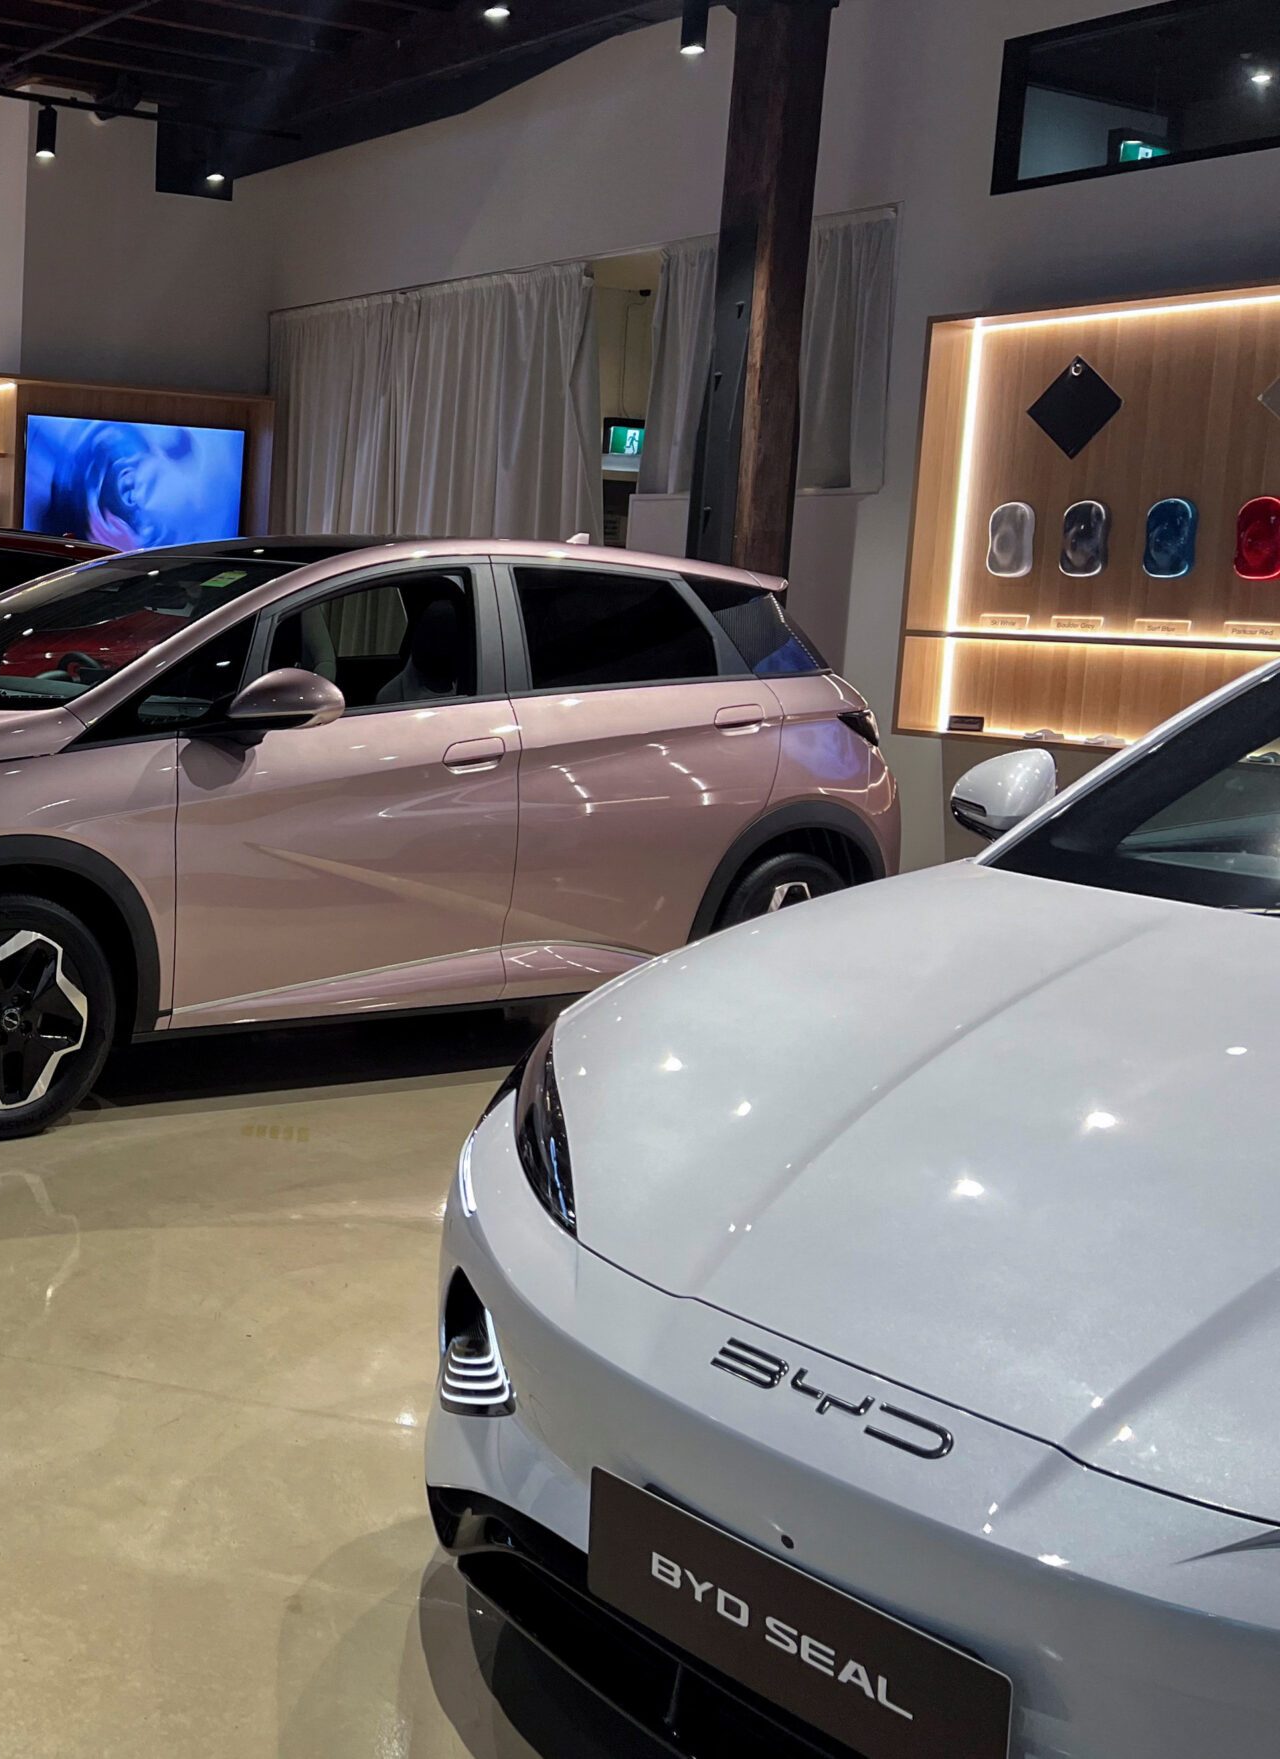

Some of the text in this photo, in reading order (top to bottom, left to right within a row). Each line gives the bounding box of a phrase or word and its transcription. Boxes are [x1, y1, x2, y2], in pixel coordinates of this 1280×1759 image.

[1259, 628, 1274, 636] Red
[710, 1337, 955, 1460] BYD
[651, 1551, 913, 1720] BYD SEAL
